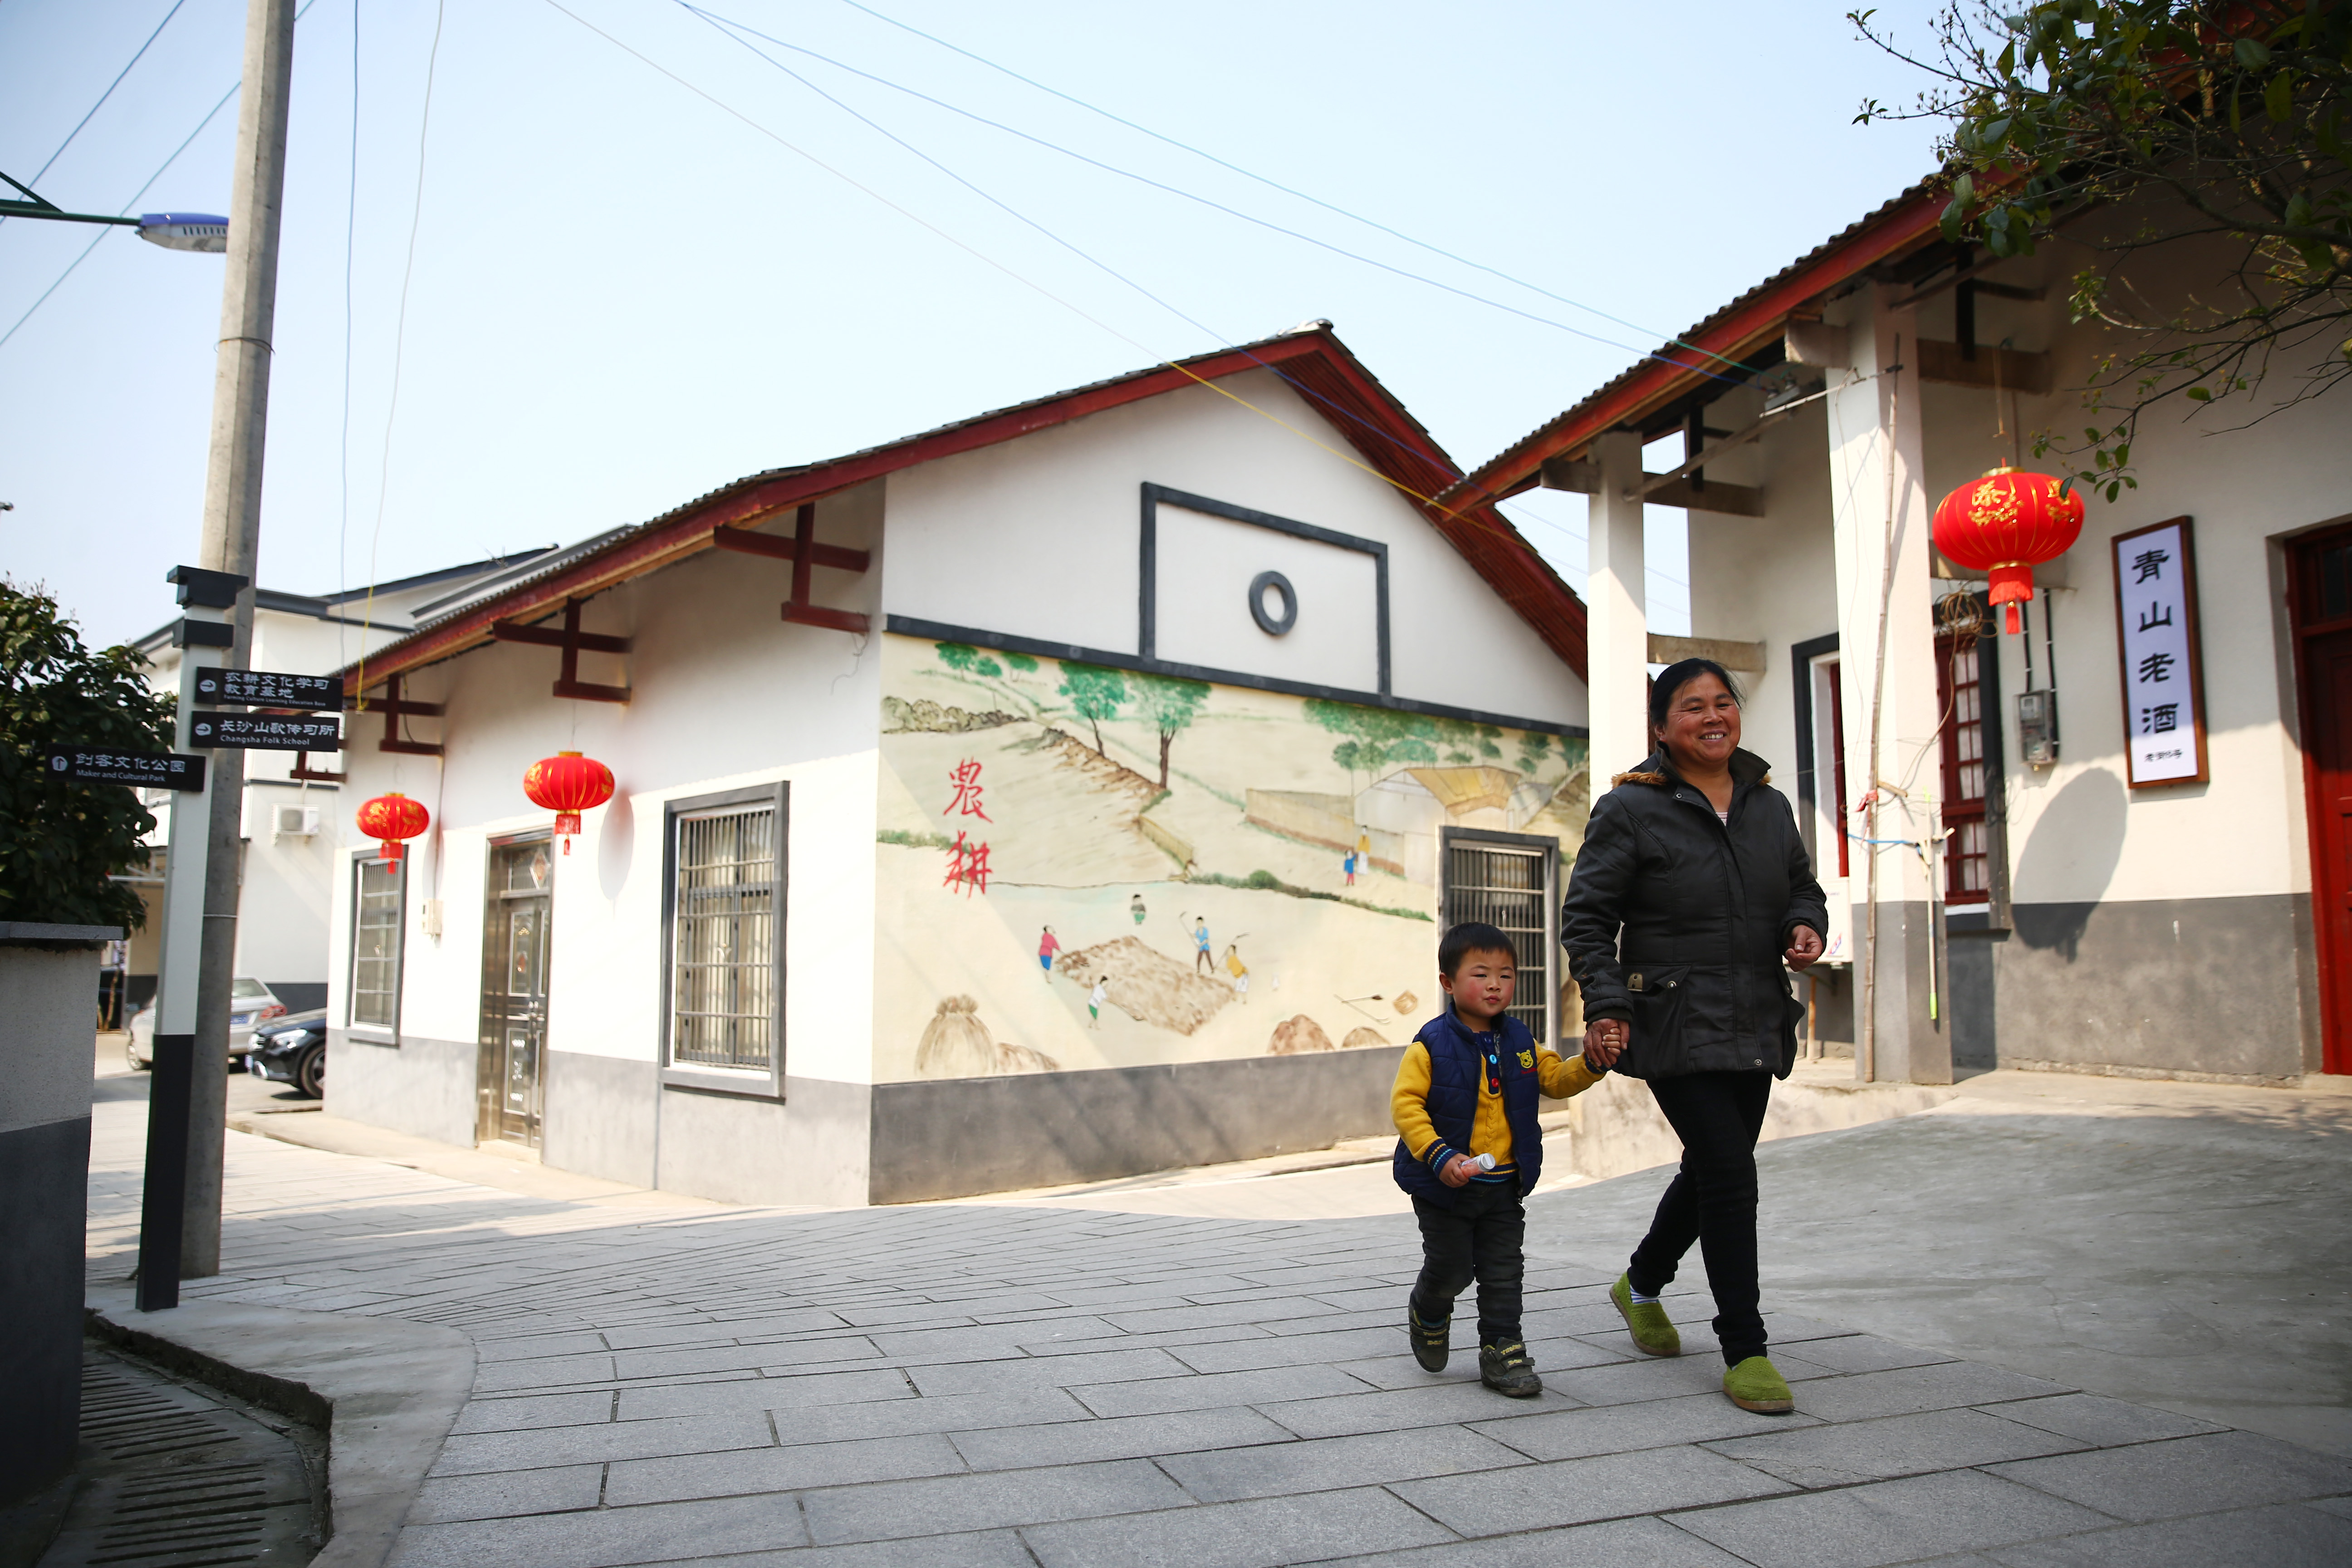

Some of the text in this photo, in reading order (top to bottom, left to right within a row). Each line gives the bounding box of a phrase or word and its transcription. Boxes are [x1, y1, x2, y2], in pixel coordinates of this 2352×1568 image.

[2132, 549, 2180, 734] 青山老酒
[225, 672, 329, 690] 农耕文化学习
[224, 683, 294, 699] 教育基地
[220, 720, 335, 736] 长沙山歌传习所
[220, 735, 260, 744] Changsha
[75, 753, 186, 772] 创客文化公园
[118, 772, 148, 780] Cultural
